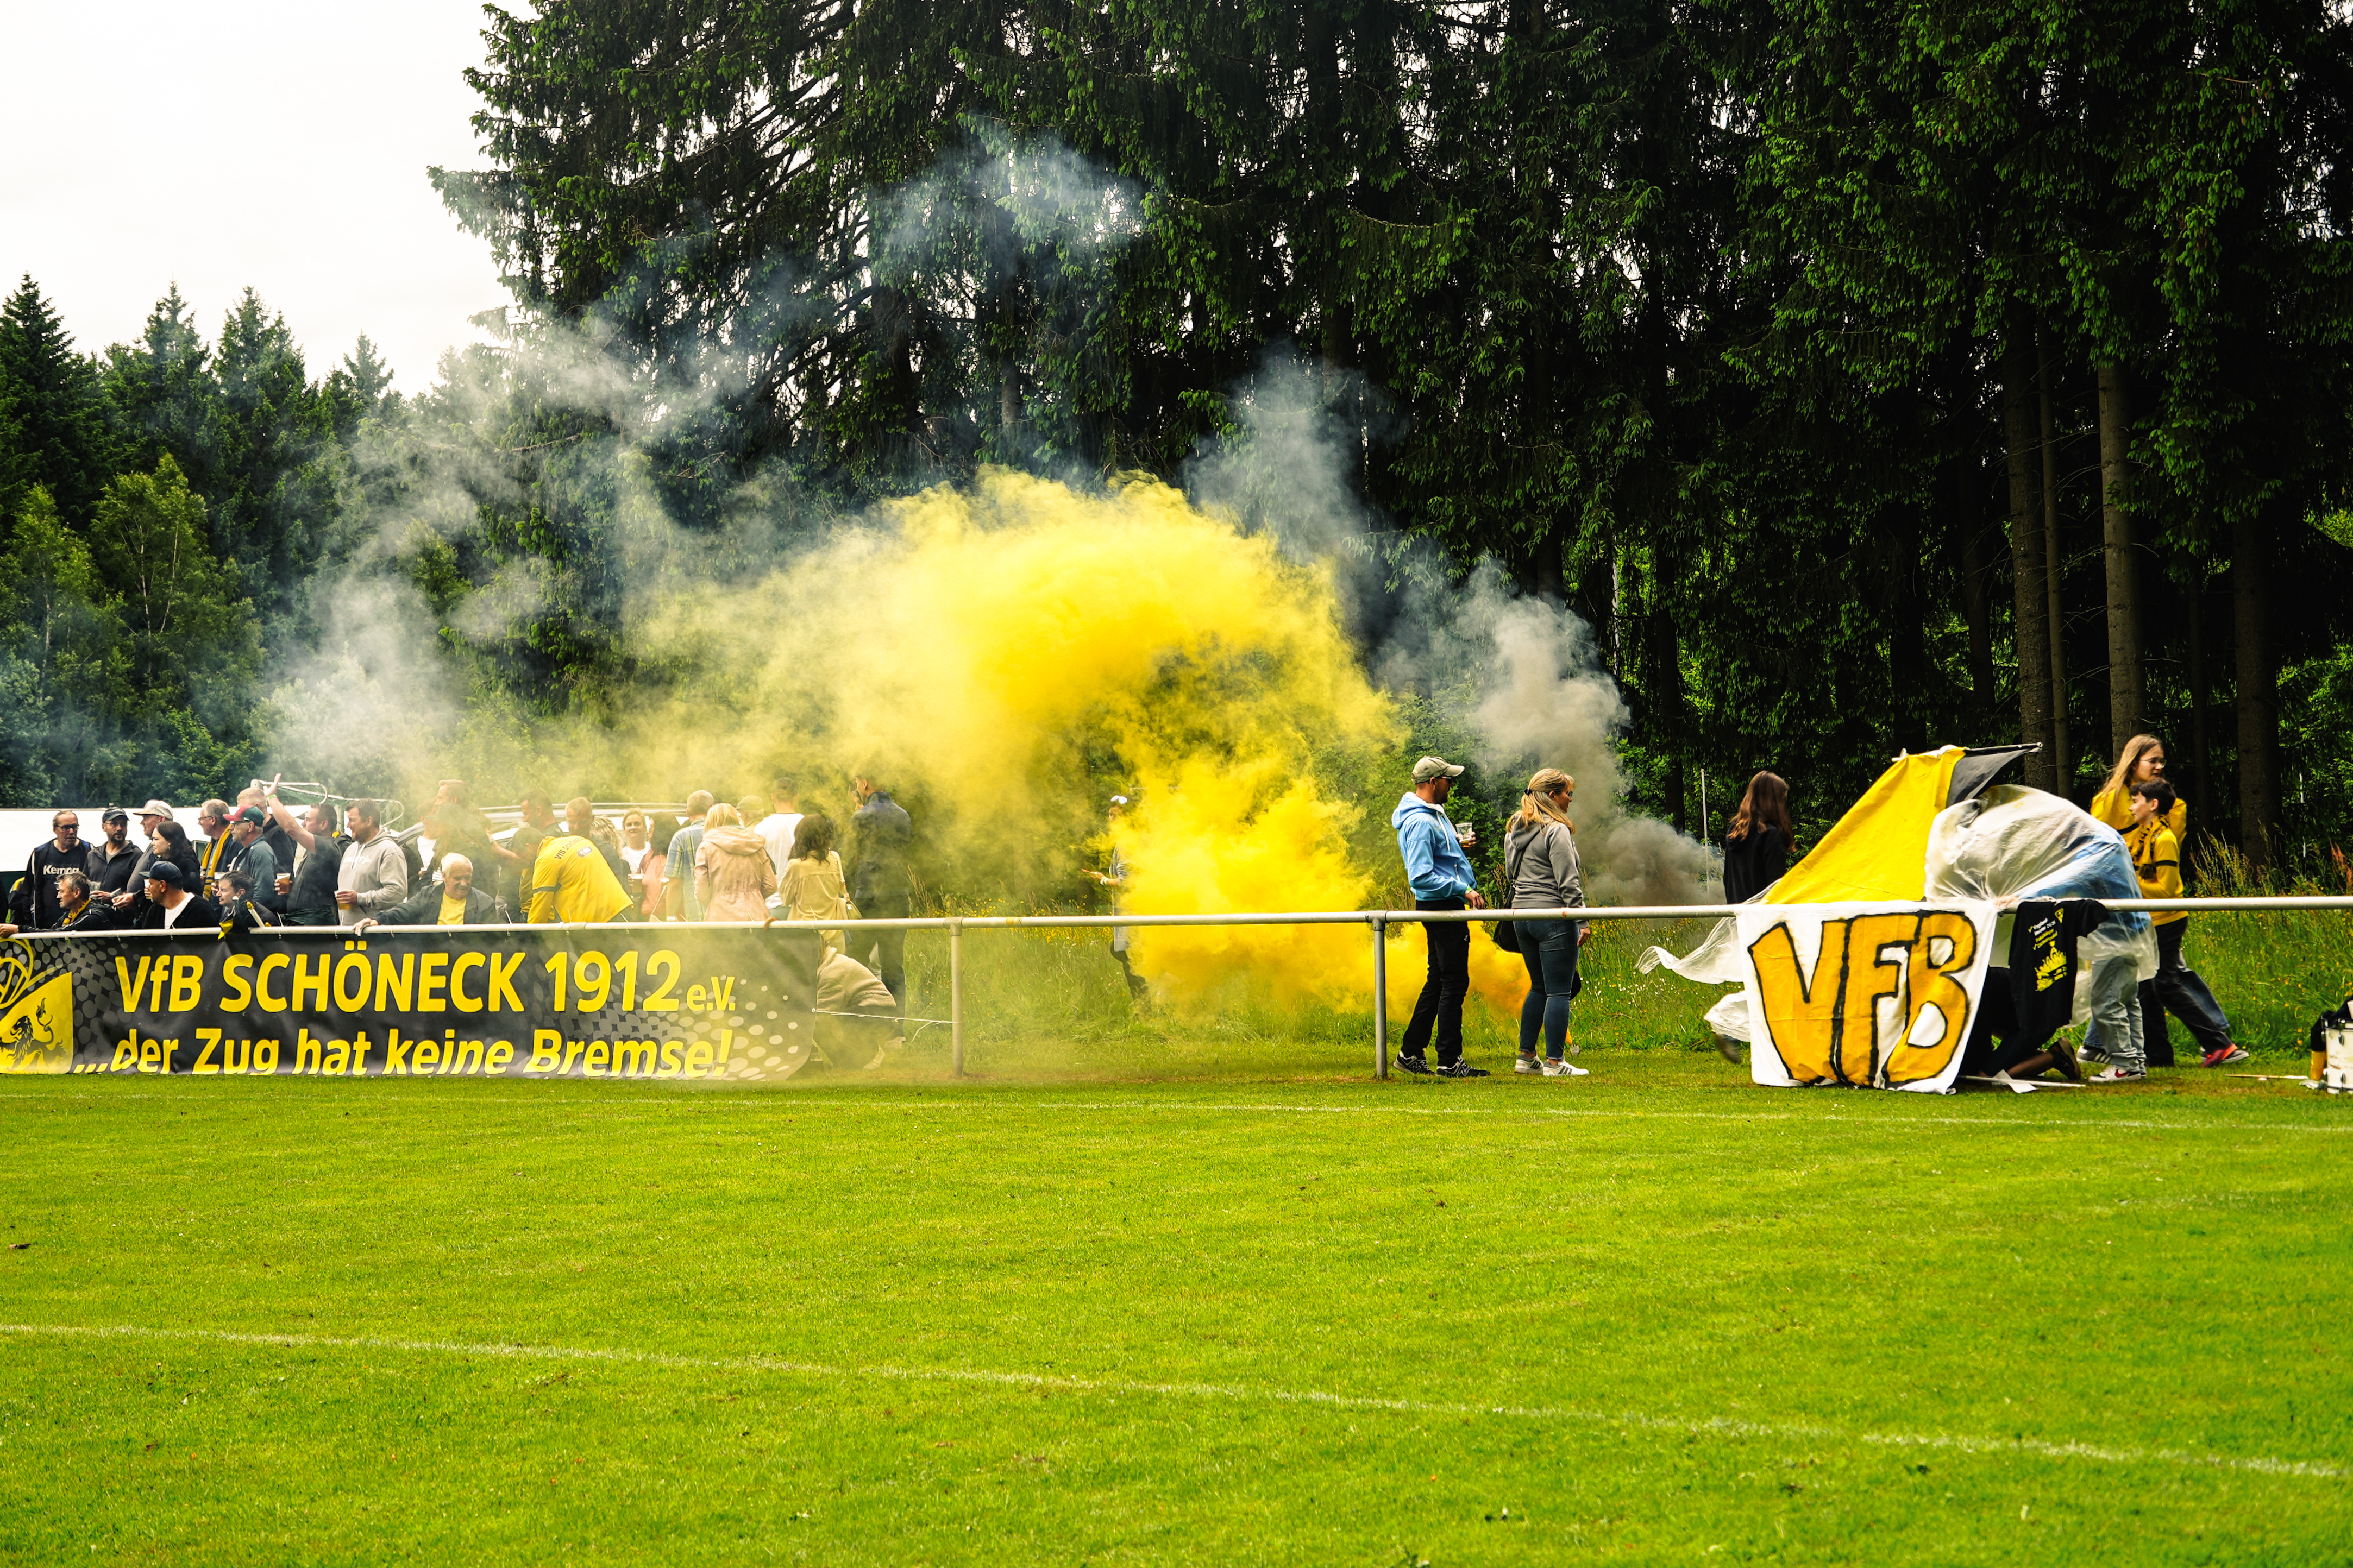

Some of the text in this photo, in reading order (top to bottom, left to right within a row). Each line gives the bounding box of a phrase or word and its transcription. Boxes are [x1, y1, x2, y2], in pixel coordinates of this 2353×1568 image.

[115, 940, 735, 1013] VfB SCHÖNECK 1912 e.V.
[1748, 910, 1977, 1086] VFB
[192, 1028, 279, 1076] Zug
[291, 1028, 372, 1076] hat
[381, 1029, 515, 1075] keine
[522, 1029, 733, 1077] Bremse!
